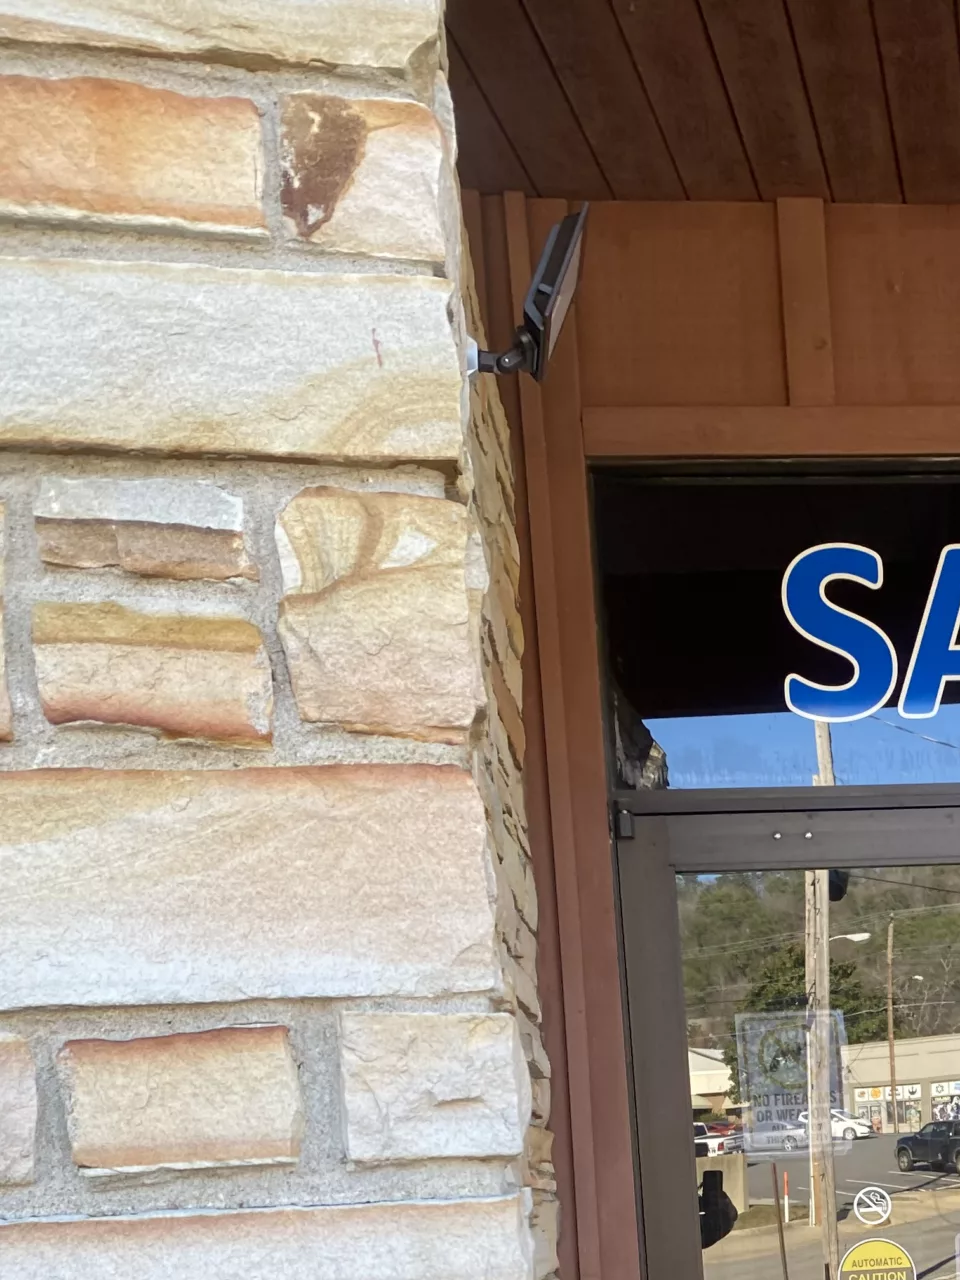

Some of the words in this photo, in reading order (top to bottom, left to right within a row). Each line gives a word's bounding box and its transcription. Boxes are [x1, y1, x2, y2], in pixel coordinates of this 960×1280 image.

[753, 1093, 770, 1107] NO
[774, 1090, 836, 1106] FIREAS
[756, 1110, 773, 1123] OR
[851, 1257, 903, 1268] AUTOMATIC
